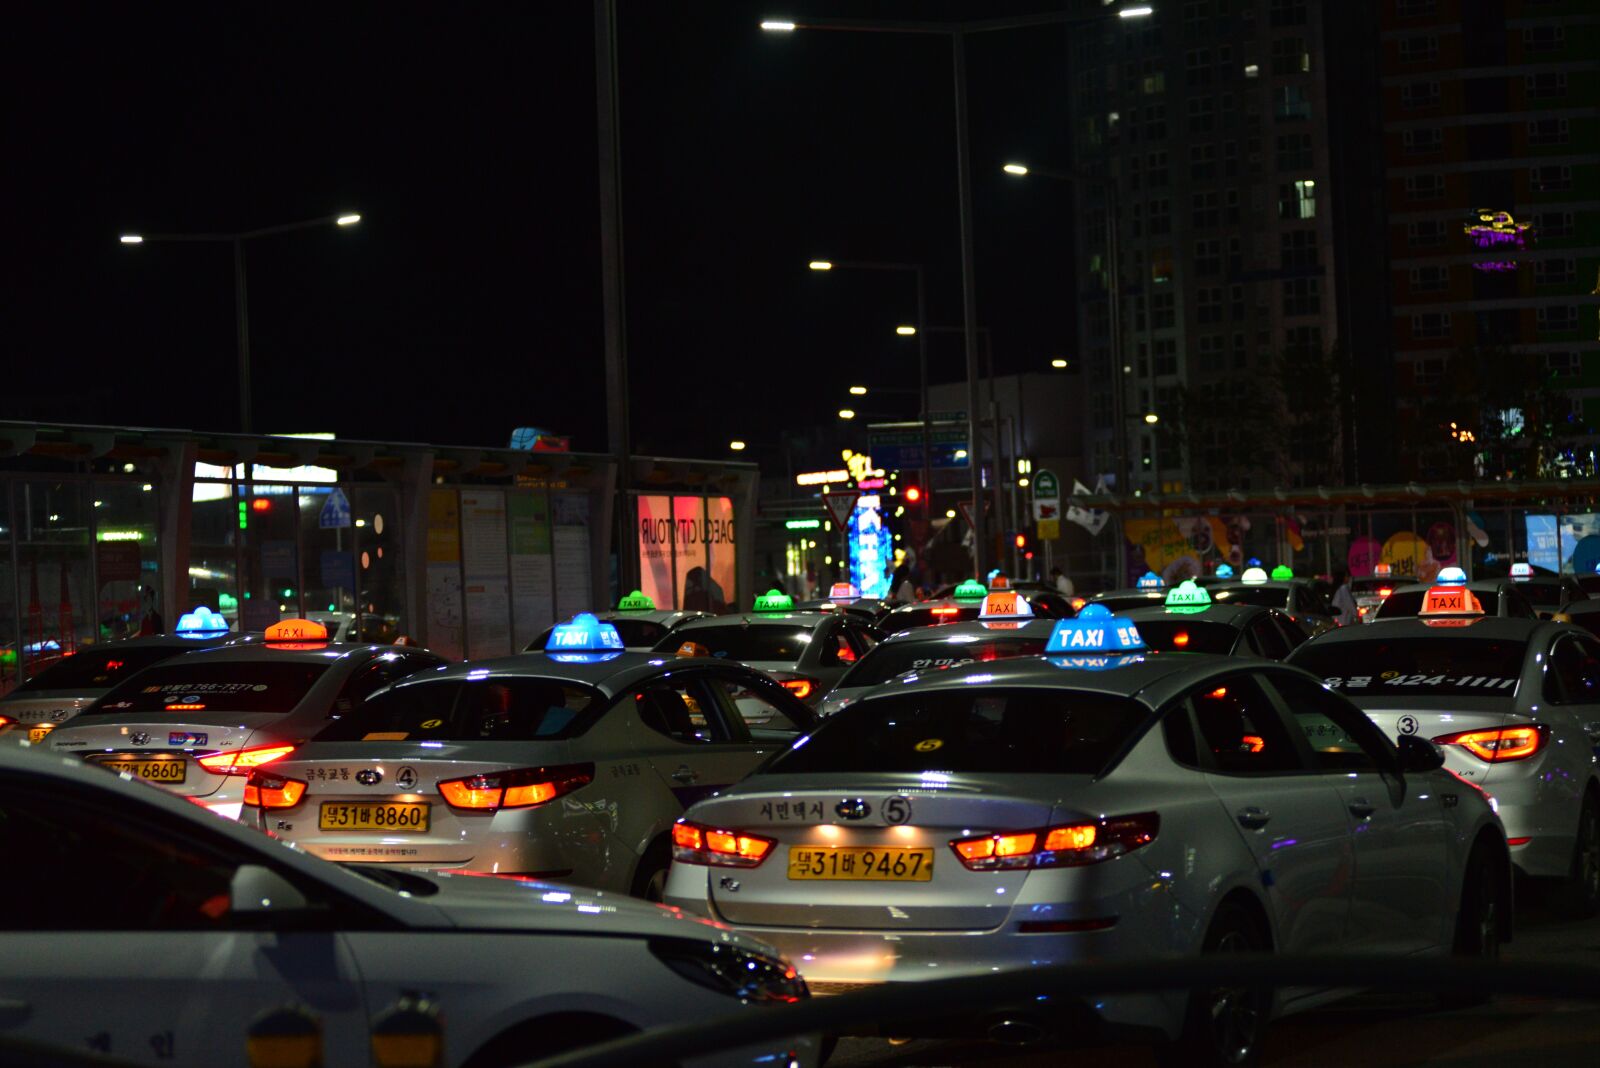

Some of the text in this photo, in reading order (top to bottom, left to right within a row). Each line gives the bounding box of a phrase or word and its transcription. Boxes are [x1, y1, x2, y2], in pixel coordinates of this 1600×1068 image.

[623, 600, 641, 608] TAXI
[759, 600, 779, 609] TAXI
[1171, 593, 1195, 602] TAXI
[1431, 597, 1461, 609] TAXI
[988, 603, 1014, 614] TAXI
[276, 627, 304, 638] TAXI
[554, 631, 589, 646] TAXI
[1059, 629, 1104, 648] TAXI
[1384, 673, 1516, 690] 424-1111
[142, 763, 179, 778] 6860
[375, 806, 421, 826] 8860
[760, 801, 824, 820] 시민택시
[863, 851, 924, 877] 9467
